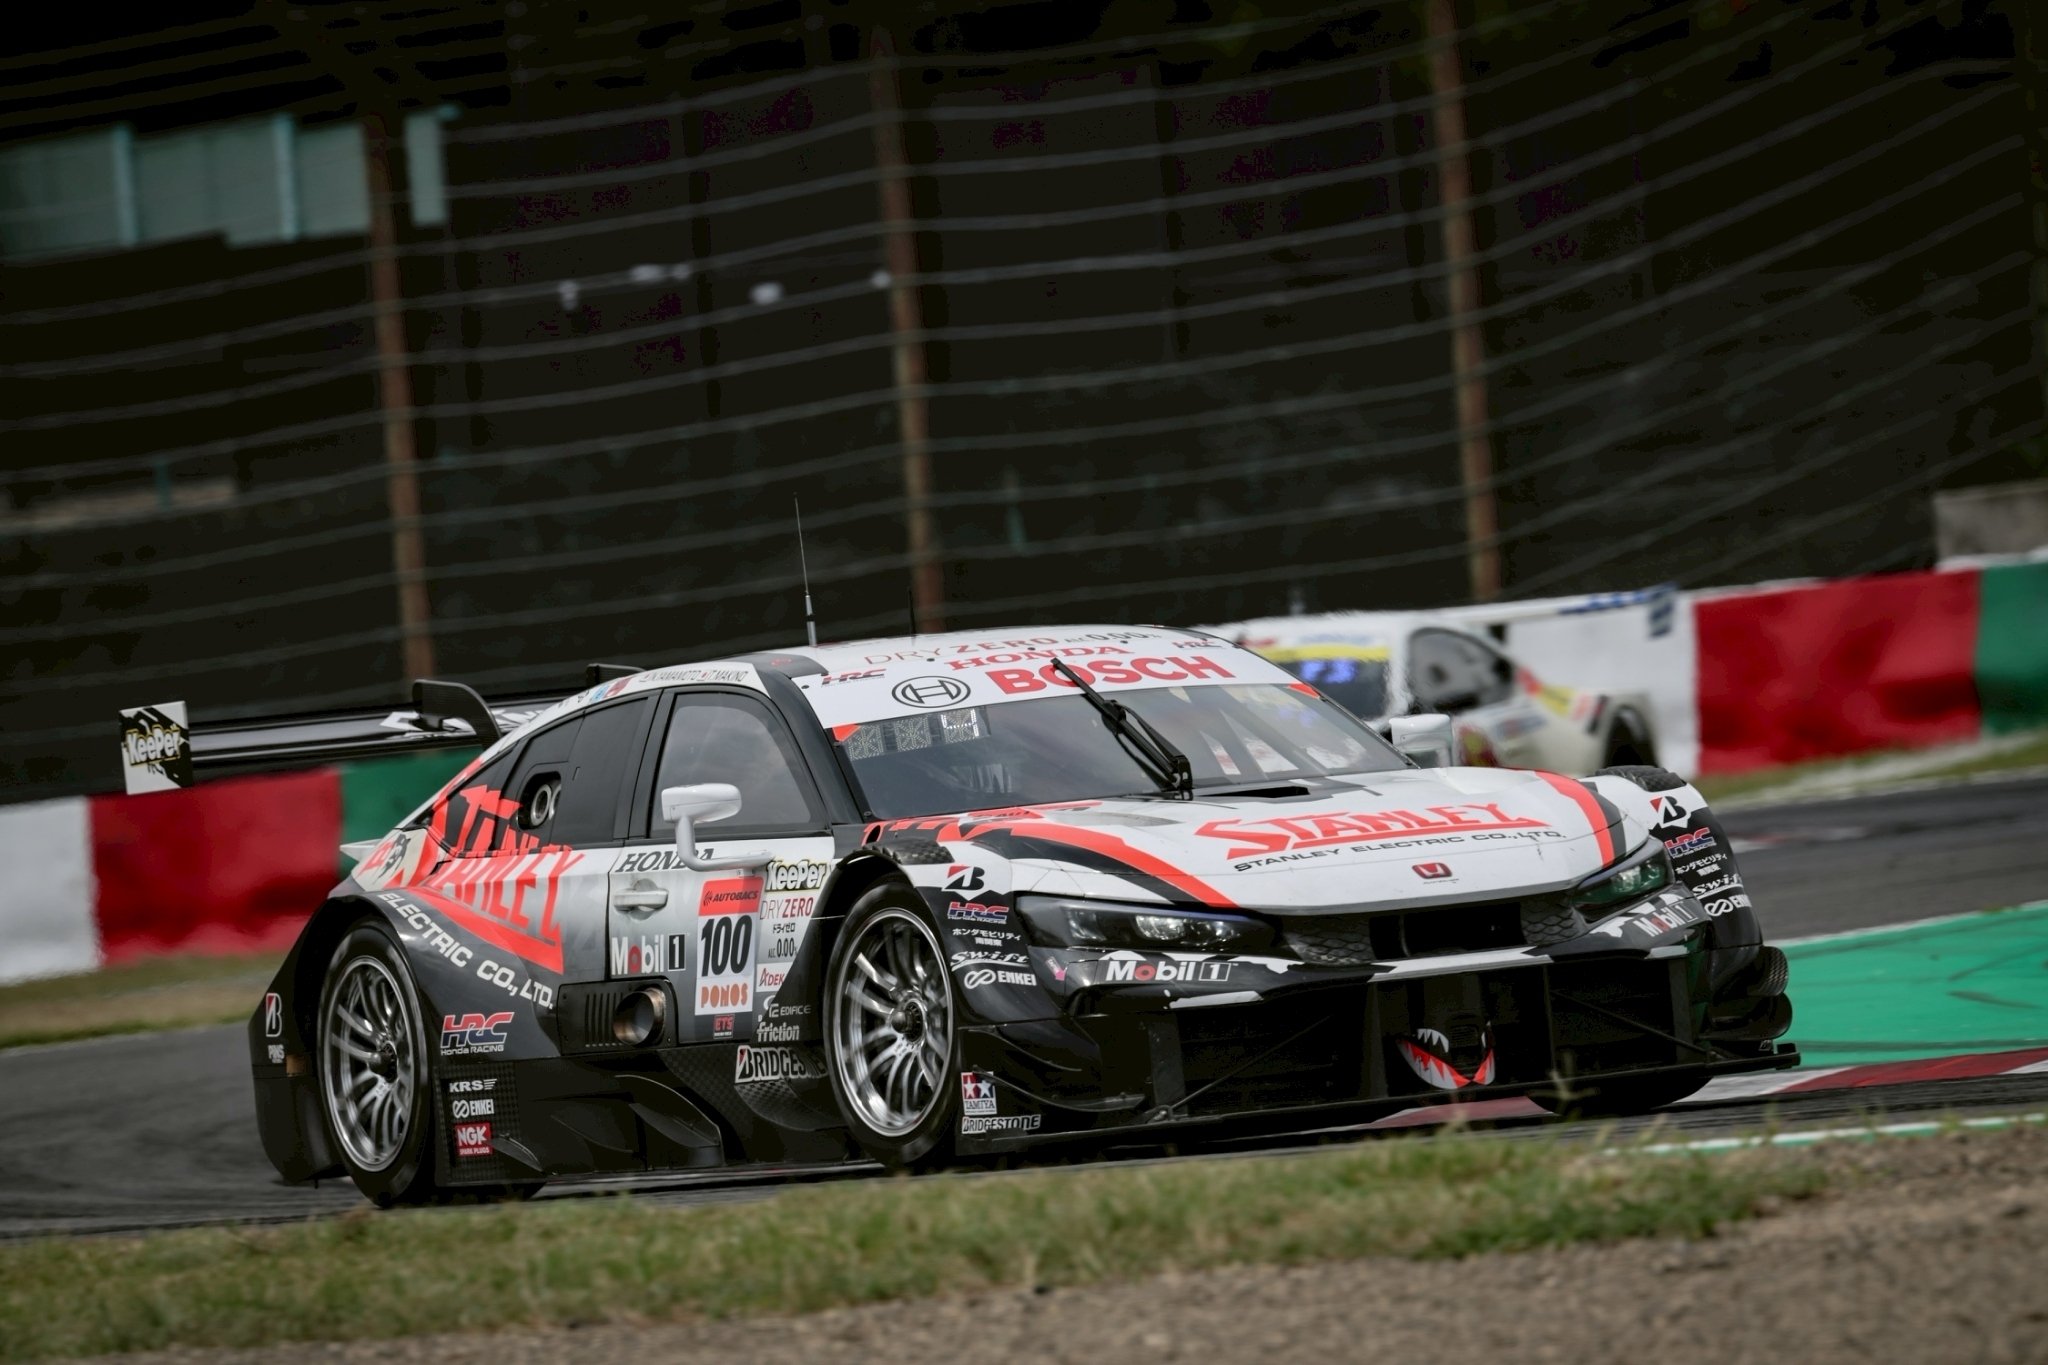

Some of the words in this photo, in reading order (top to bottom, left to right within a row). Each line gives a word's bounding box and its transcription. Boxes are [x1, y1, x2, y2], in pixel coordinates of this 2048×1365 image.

[944, 646, 1135, 671] HONDA
[985, 656, 1236, 694] BOSCH
[126, 725, 180, 765] KeePer
[1195, 803, 1551, 860] STANLEY
[1665, 827, 1714, 857] HRC
[1234, 848, 1339, 872] STANLEY
[1354, 834, 1463, 852] ELECTRIC
[765, 859, 826, 891] KeePer
[712, 890, 759, 902] AUTOBACS
[948, 902, 1009, 921] HRC
[1632, 906, 1686, 937] Mobil
[378, 893, 474, 968] ELECTRIC
[952, 928, 1021, 941] ホンダモビリティ
[611, 934, 665, 976] Mobil
[701, 914, 752, 977] 100
[997, 970, 1037, 986] ENKEI
[1106, 961, 1194, 981] Mobil
[701, 983, 748, 1008] PONOS
[780, 1005, 812, 1016] EDIFICE
[441, 1012, 514, 1048] HRC
[757, 1022, 800, 1042] friction
[441, 1047, 469, 1056] Honda
[470, 1044, 504, 1054] RACING
[449, 1080, 484, 1093] KRS
[469, 1099, 495, 1116] ENKEI
[964, 1099, 995, 1110] TAMIYA
[962, 1114, 1041, 1134] BRIDGESTONE
[457, 1126, 487, 1146] NGK
